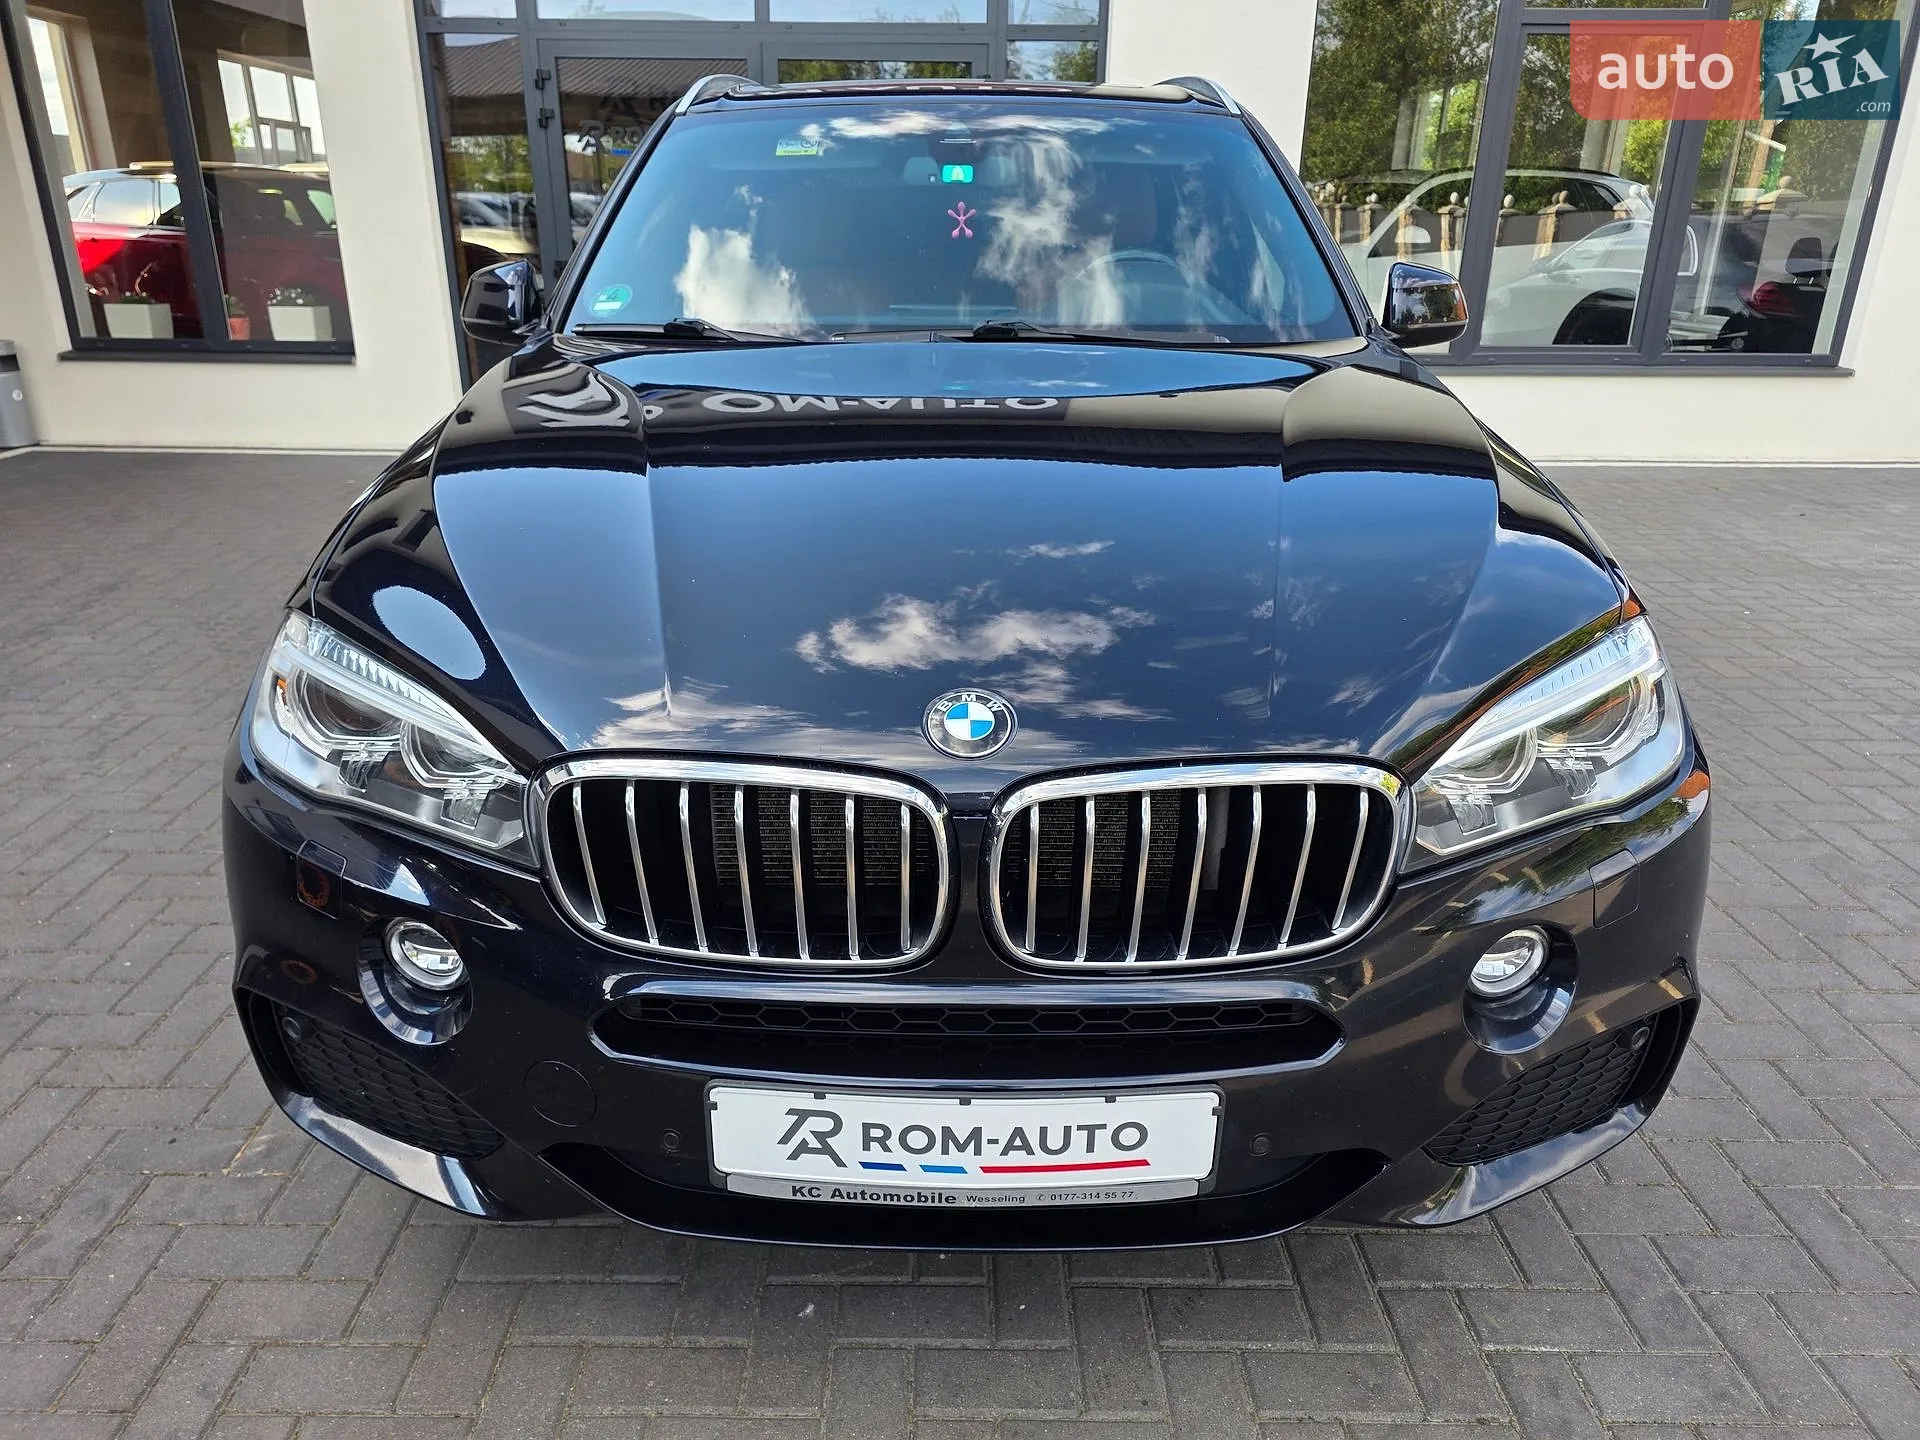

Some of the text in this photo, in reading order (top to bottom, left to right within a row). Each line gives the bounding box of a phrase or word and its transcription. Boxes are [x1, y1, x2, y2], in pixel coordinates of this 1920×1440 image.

[937, 694, 1004, 712] BMW
[861, 1121, 1149, 1156] ROM-AUTO
[791, 1185, 1134, 1204] KC Automobile Wesseling 0177-314 55 77
